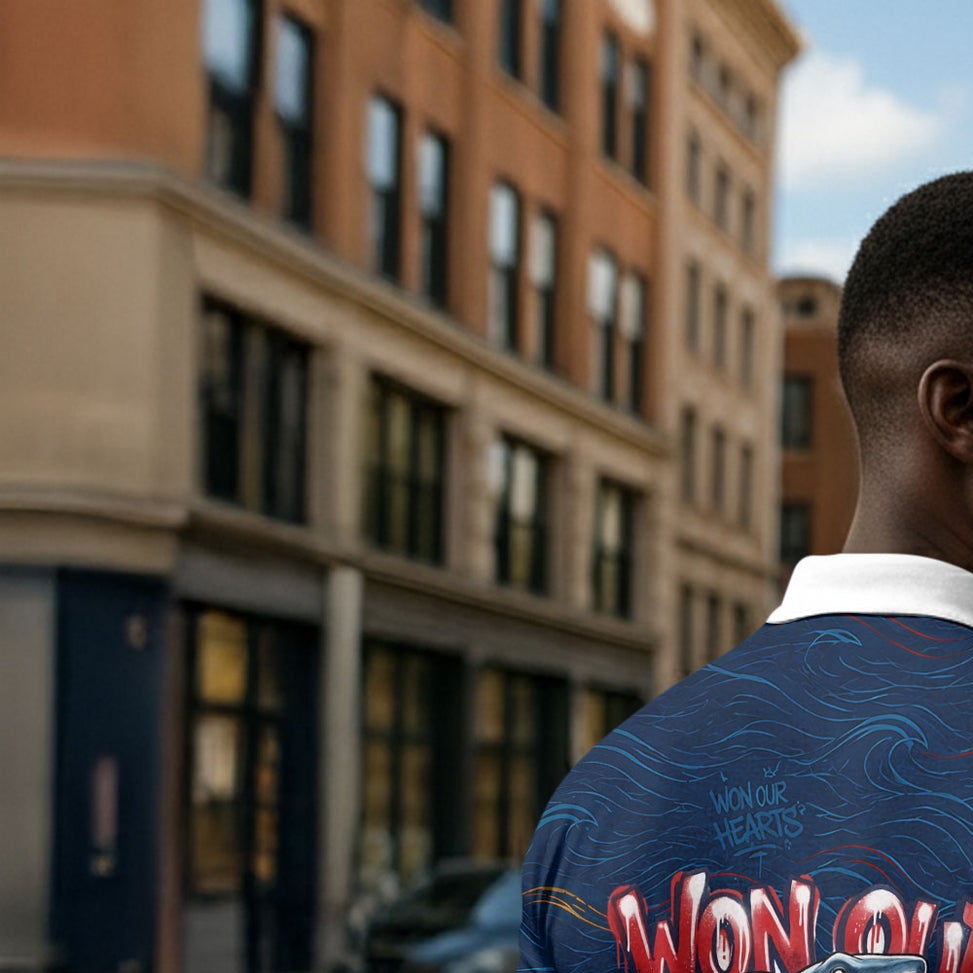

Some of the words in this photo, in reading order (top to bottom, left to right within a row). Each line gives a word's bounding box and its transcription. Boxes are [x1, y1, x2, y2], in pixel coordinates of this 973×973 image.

[709, 780, 754, 815] WON
[755, 781, 789, 808] OUR
[712, 804, 804, 851] HEARTS
